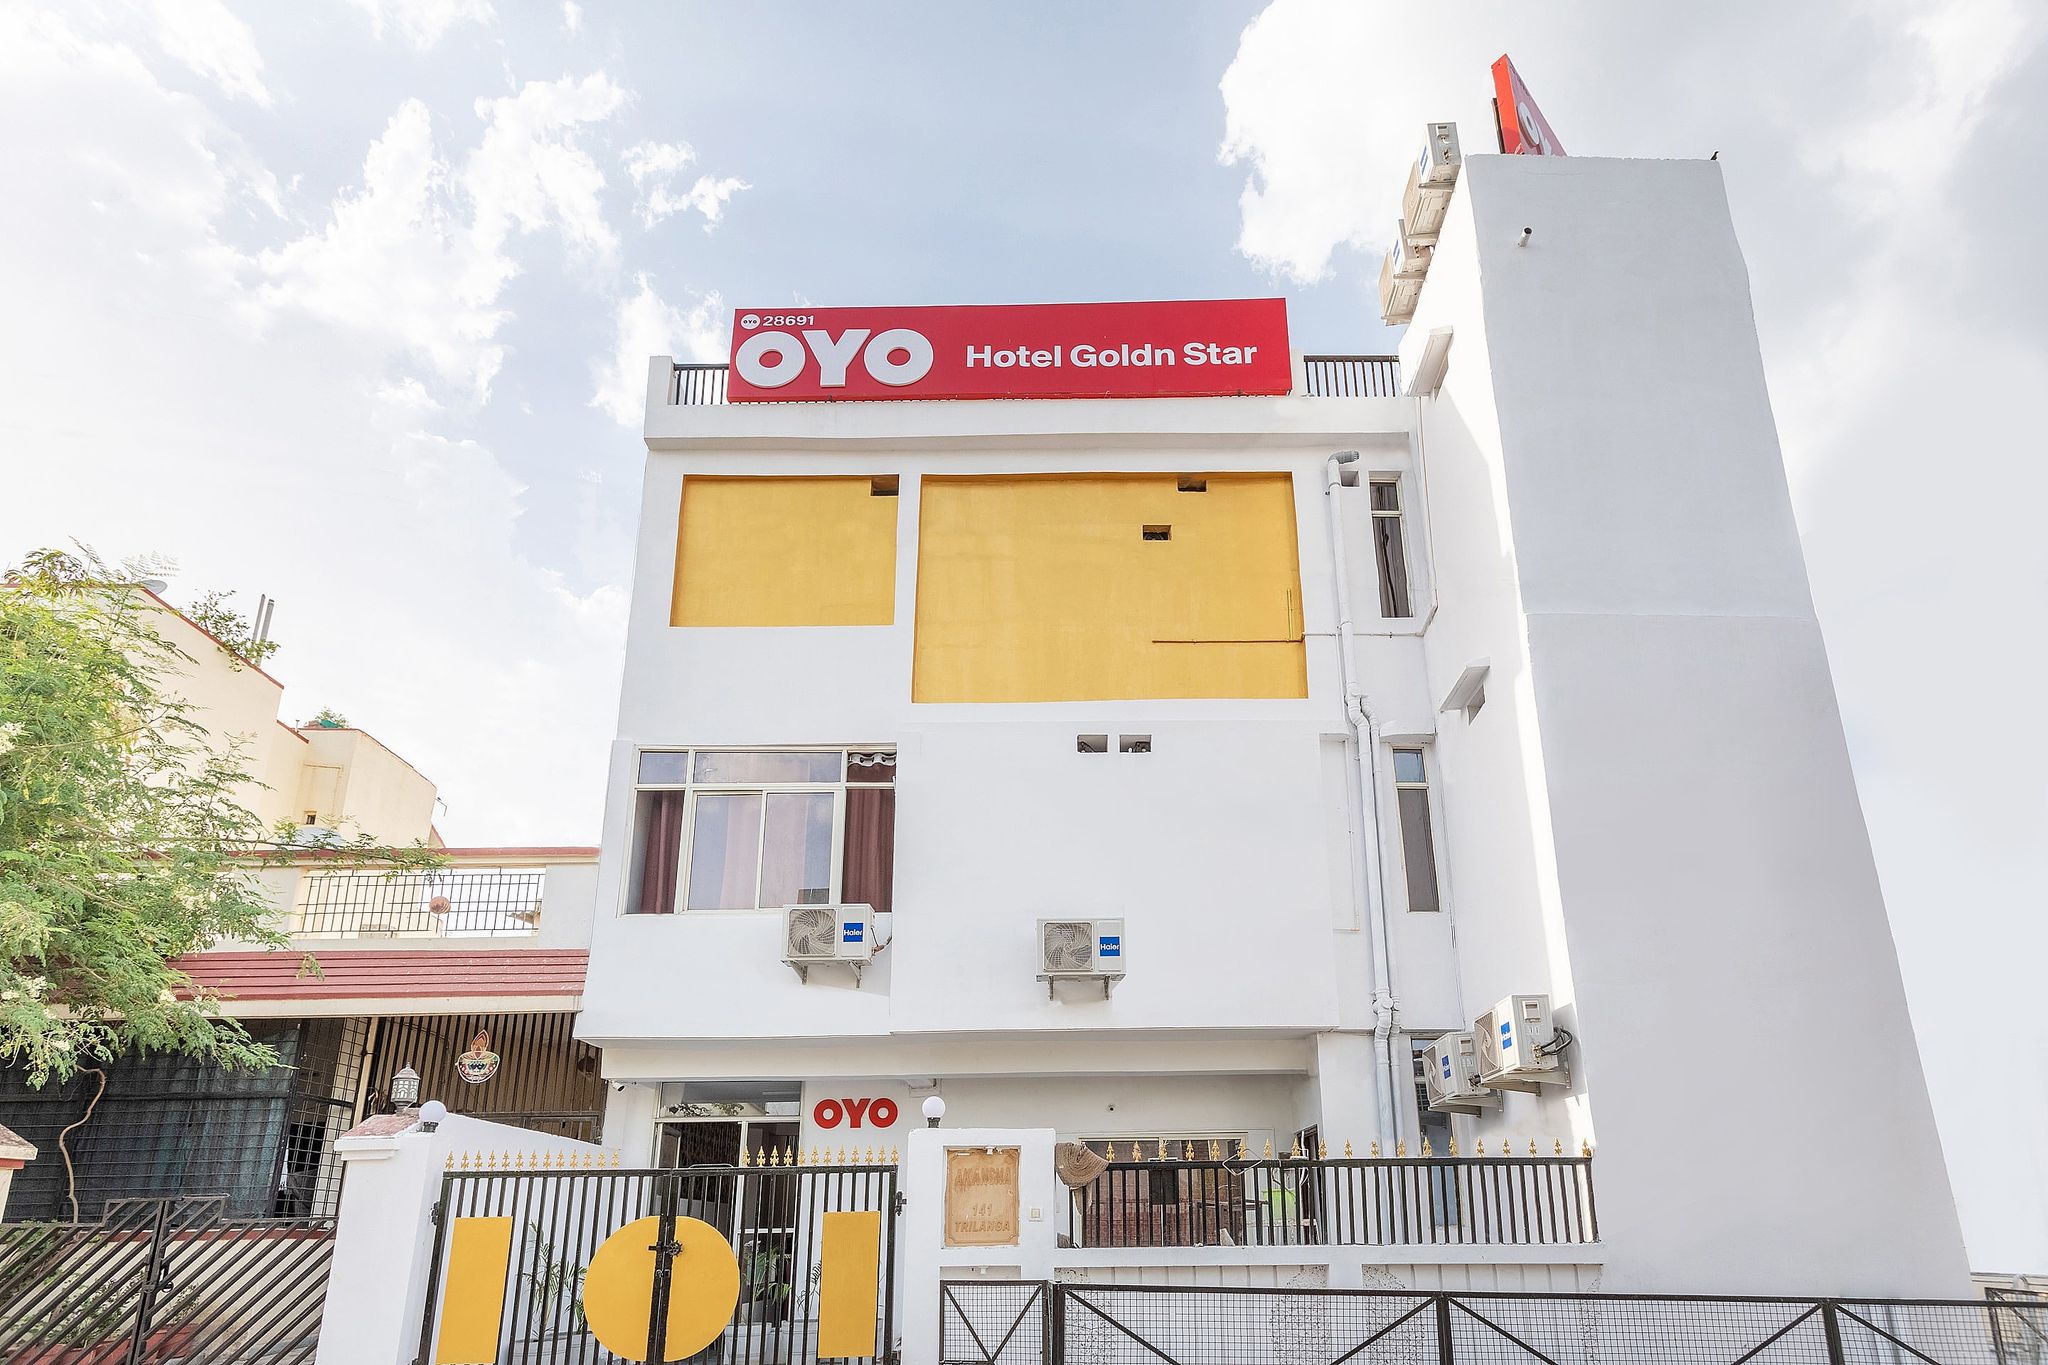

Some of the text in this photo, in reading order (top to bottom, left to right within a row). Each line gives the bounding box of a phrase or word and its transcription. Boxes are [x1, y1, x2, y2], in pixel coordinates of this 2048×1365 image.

[763, 315, 814, 326] 28691
[736, 329, 934, 388] OYO
[966, 342, 1257, 368] Hotel Goldn Star
[1100, 943, 1120, 951] Haier
[813, 1097, 899, 1129] OYO
[972, 1203, 993, 1217] 141
